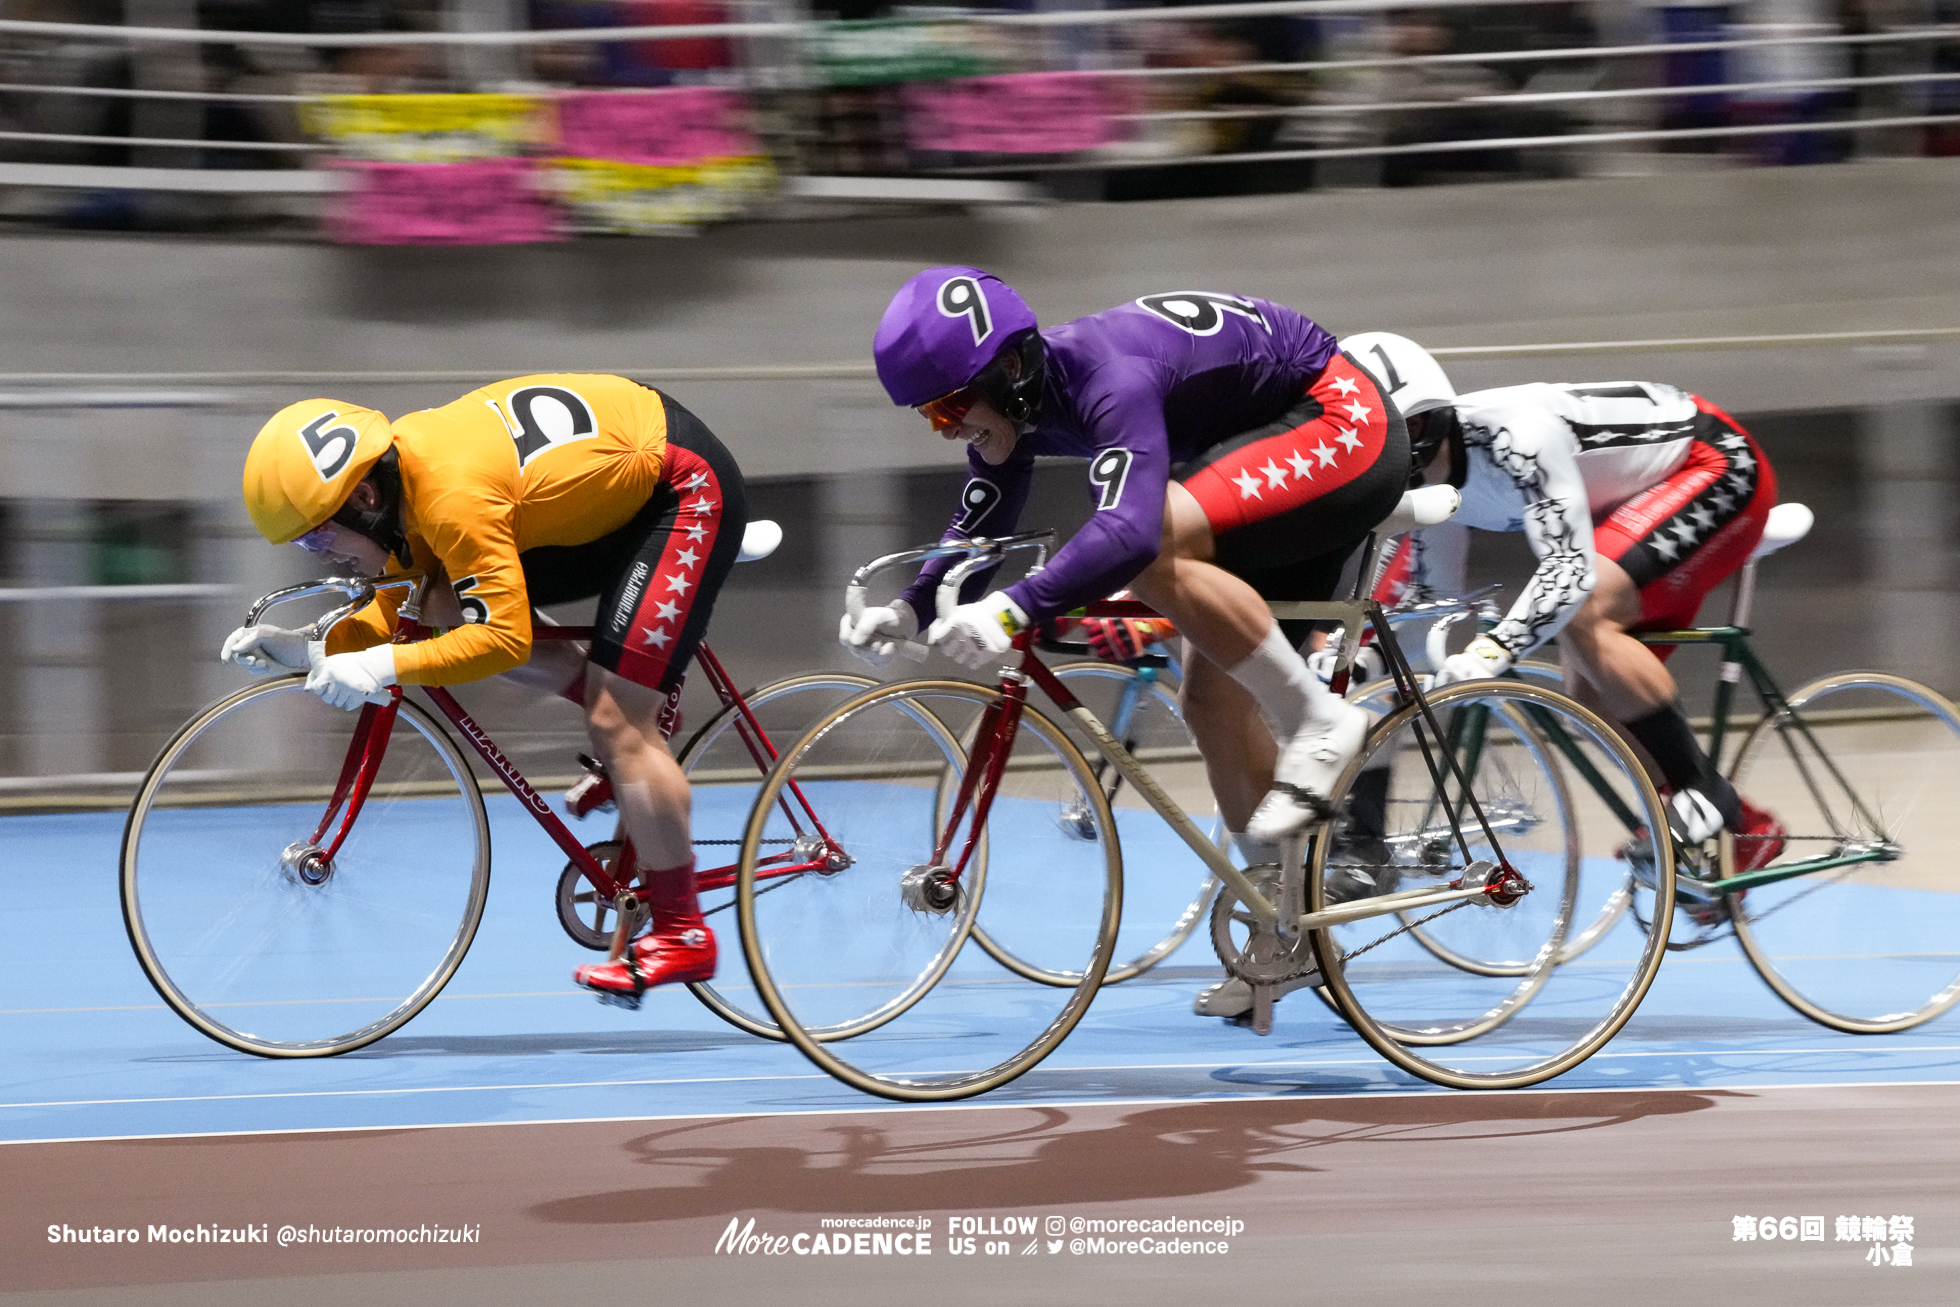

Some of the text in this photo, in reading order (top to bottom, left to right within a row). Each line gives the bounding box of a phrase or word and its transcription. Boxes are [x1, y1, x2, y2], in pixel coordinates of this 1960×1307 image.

[936, 276, 994, 347] 9
[1136, 290, 1272, 336] 9
[1370, 344, 1409, 394] 1
[298, 410, 359, 484] 5
[485, 384, 599, 477] 5
[953, 477, 1001, 534] 9
[1089, 448, 1134, 511] 9
[451, 575, 491, 626] 5
[460, 716, 551, 815] MAKINO
